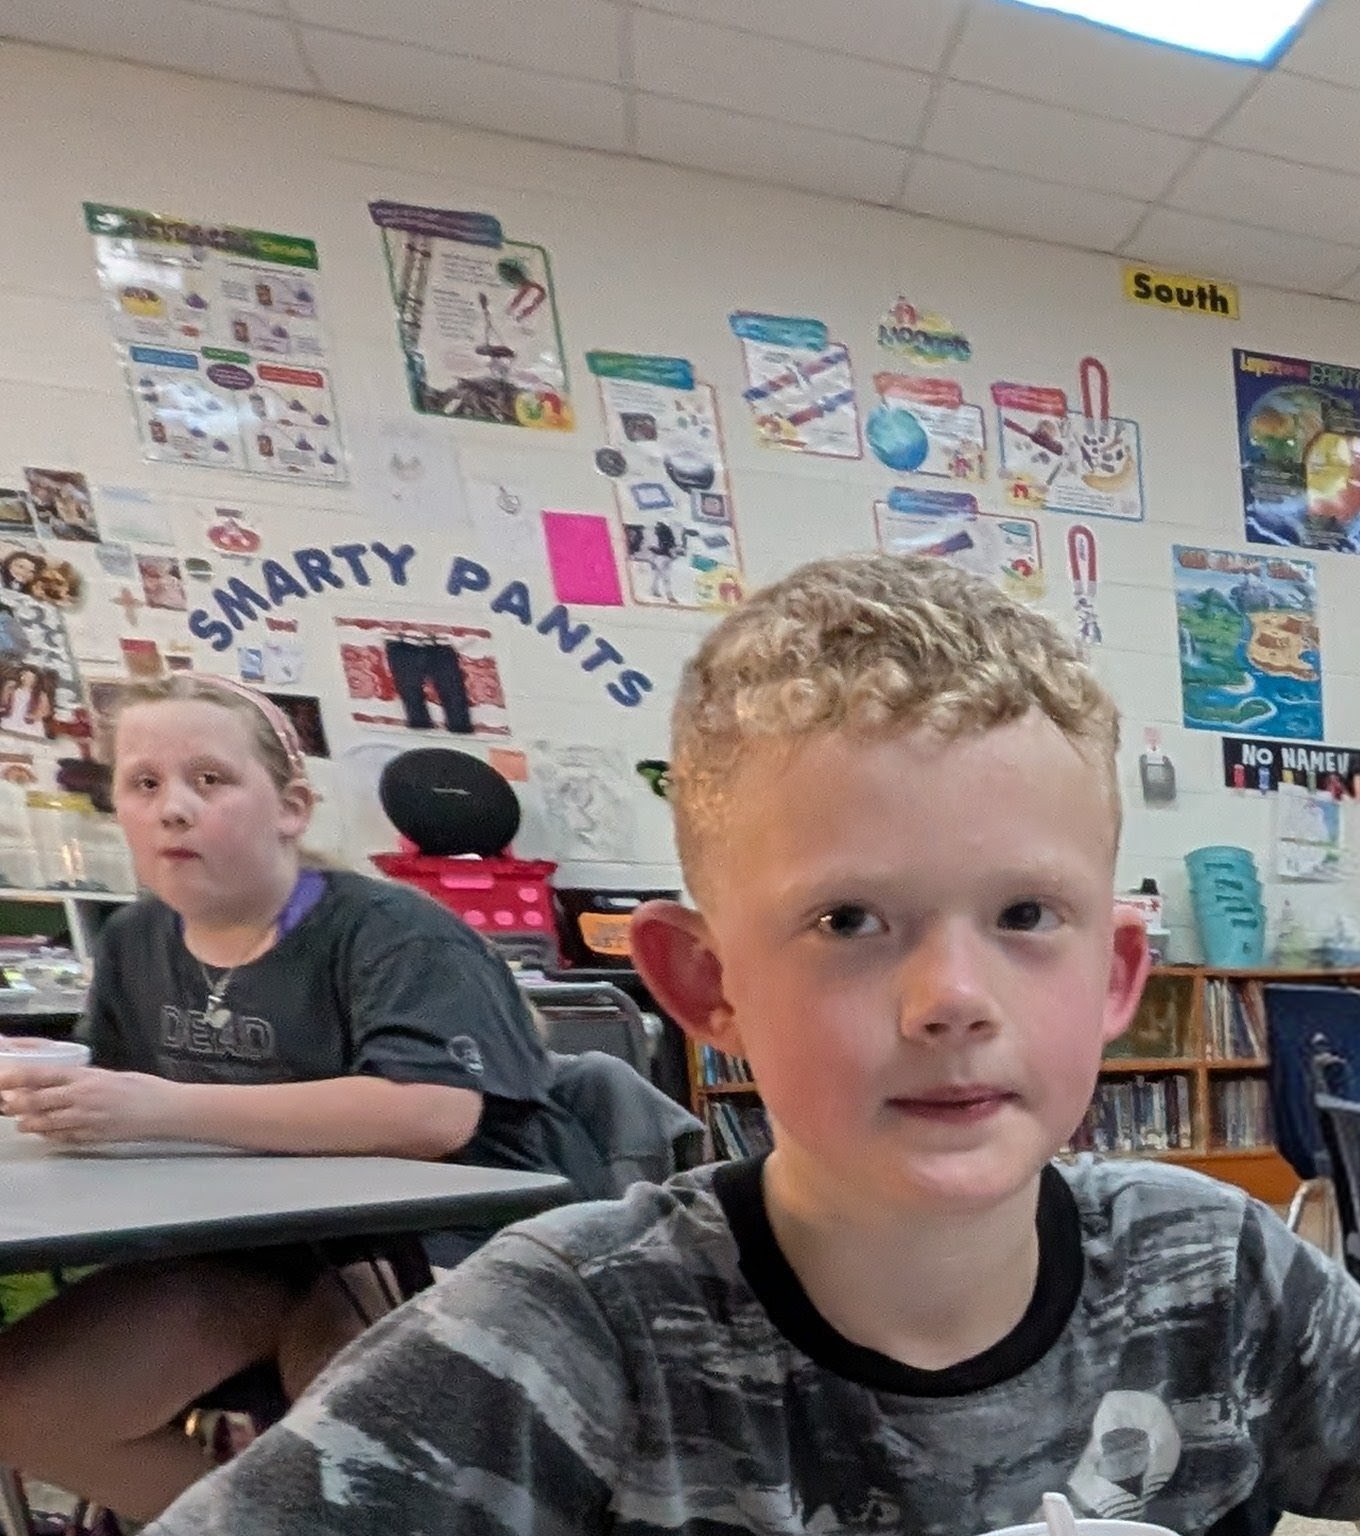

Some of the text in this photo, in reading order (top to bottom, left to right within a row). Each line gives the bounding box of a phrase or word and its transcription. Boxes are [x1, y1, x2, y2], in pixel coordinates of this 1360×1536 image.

[1133, 271, 1230, 315] South
[188, 542, 655, 708] SMARTY PANTS
[1241, 743, 1274, 767] NO
